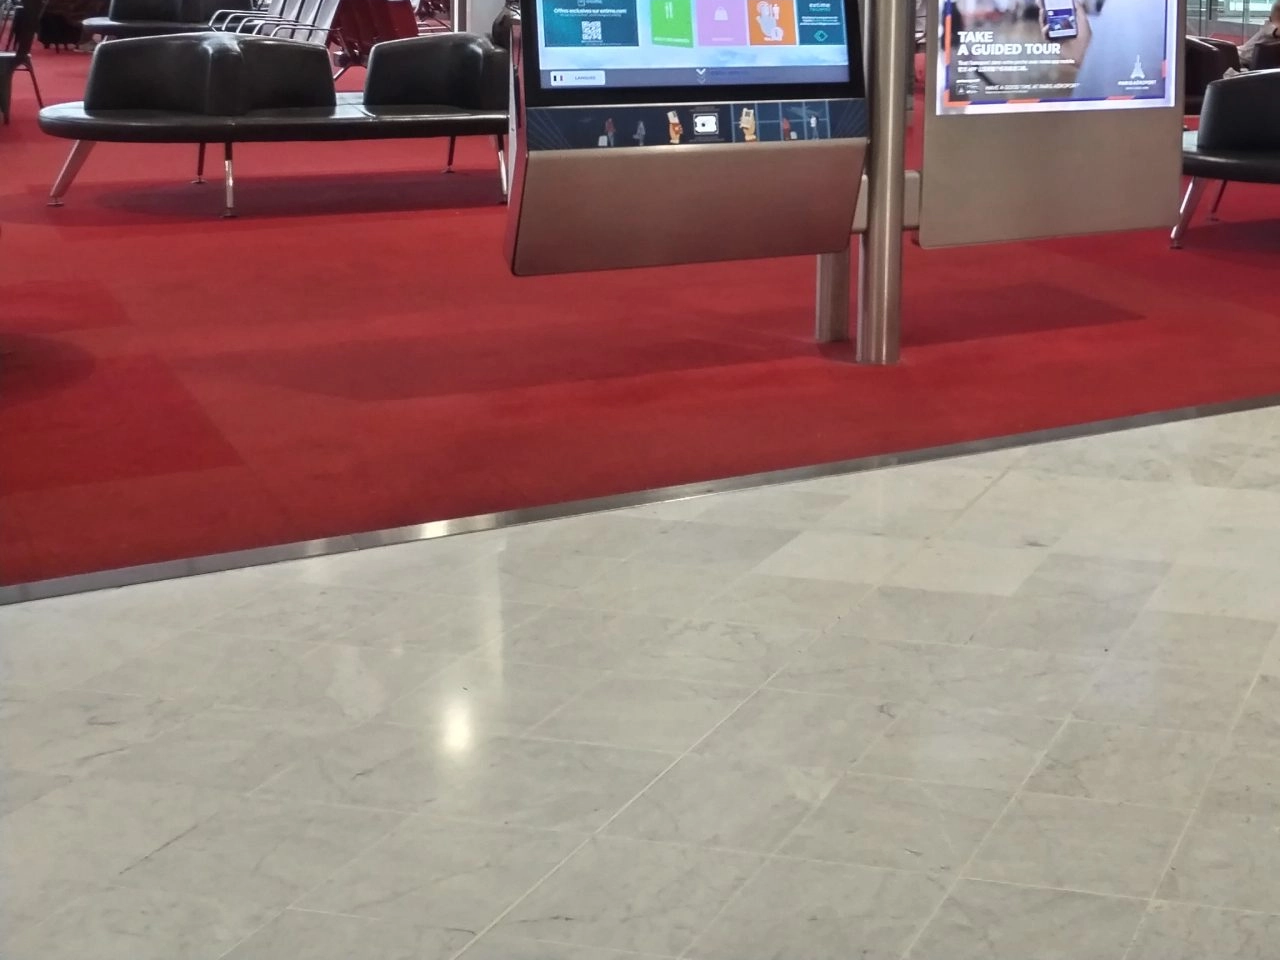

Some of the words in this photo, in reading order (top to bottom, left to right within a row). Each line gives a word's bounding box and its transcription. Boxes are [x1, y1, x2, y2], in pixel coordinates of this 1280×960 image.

[957, 31, 993, 43] TAKE
[956, 44, 969, 55] A
[971, 43, 1022, 55] GUIDED
[1025, 43, 1060, 55] TOUR
